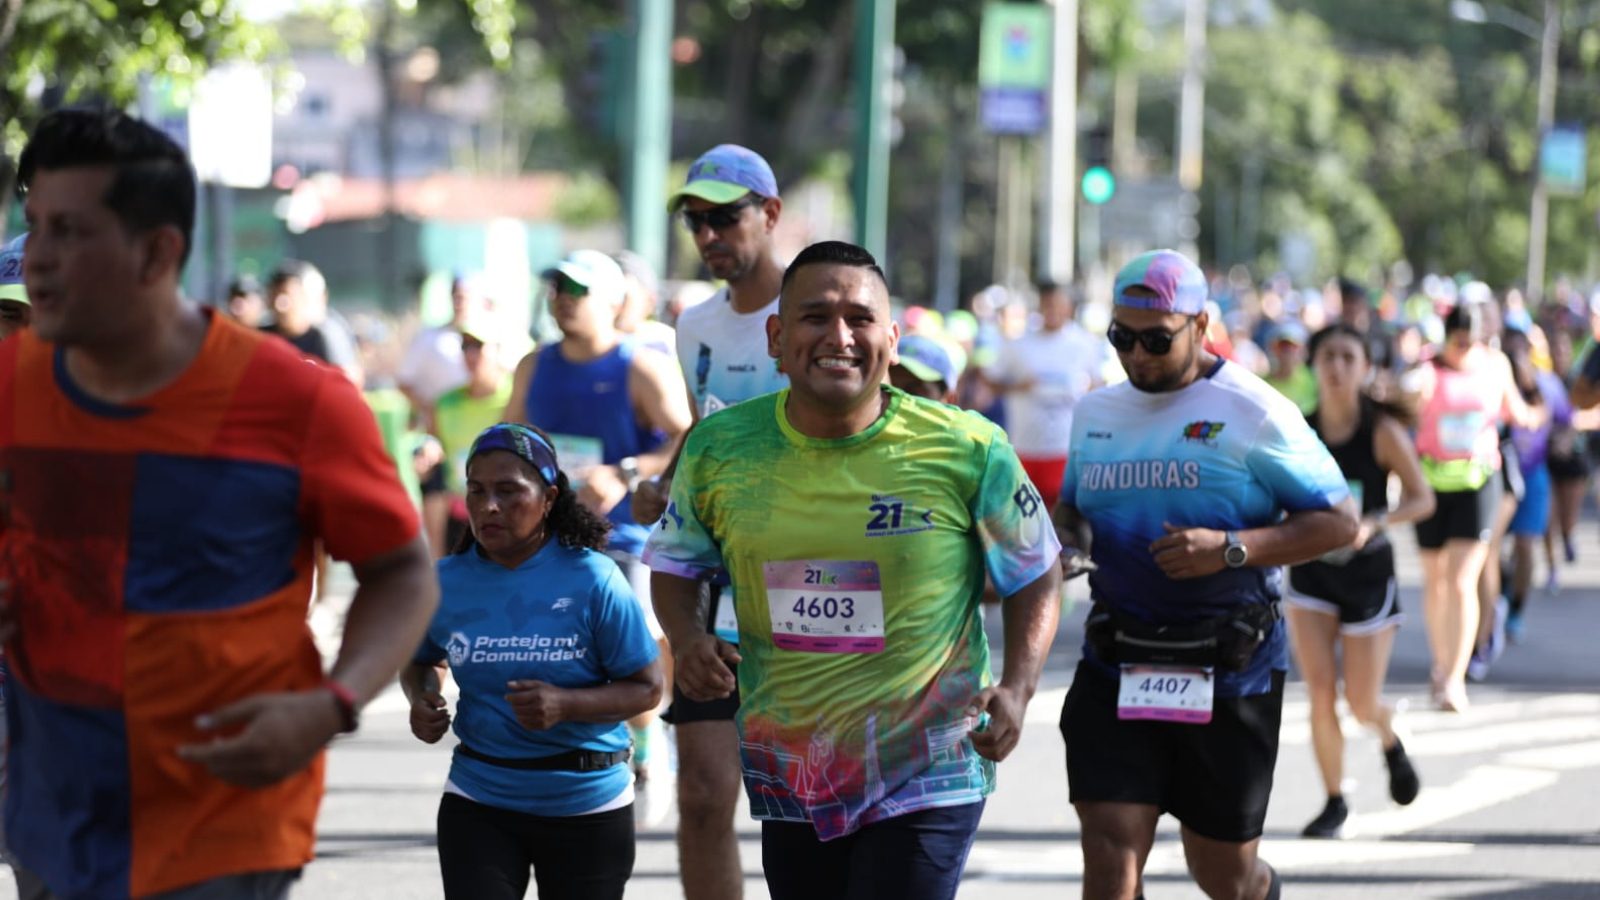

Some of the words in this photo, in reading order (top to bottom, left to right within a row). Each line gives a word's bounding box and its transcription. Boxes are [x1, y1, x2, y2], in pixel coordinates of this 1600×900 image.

[1082, 459, 1200, 491] HONDURAS
[792, 596, 855, 619] 4603
[474, 633, 552, 650] Protejo
[554, 633, 579, 648] mi
[1139, 677, 1192, 695] 4407
